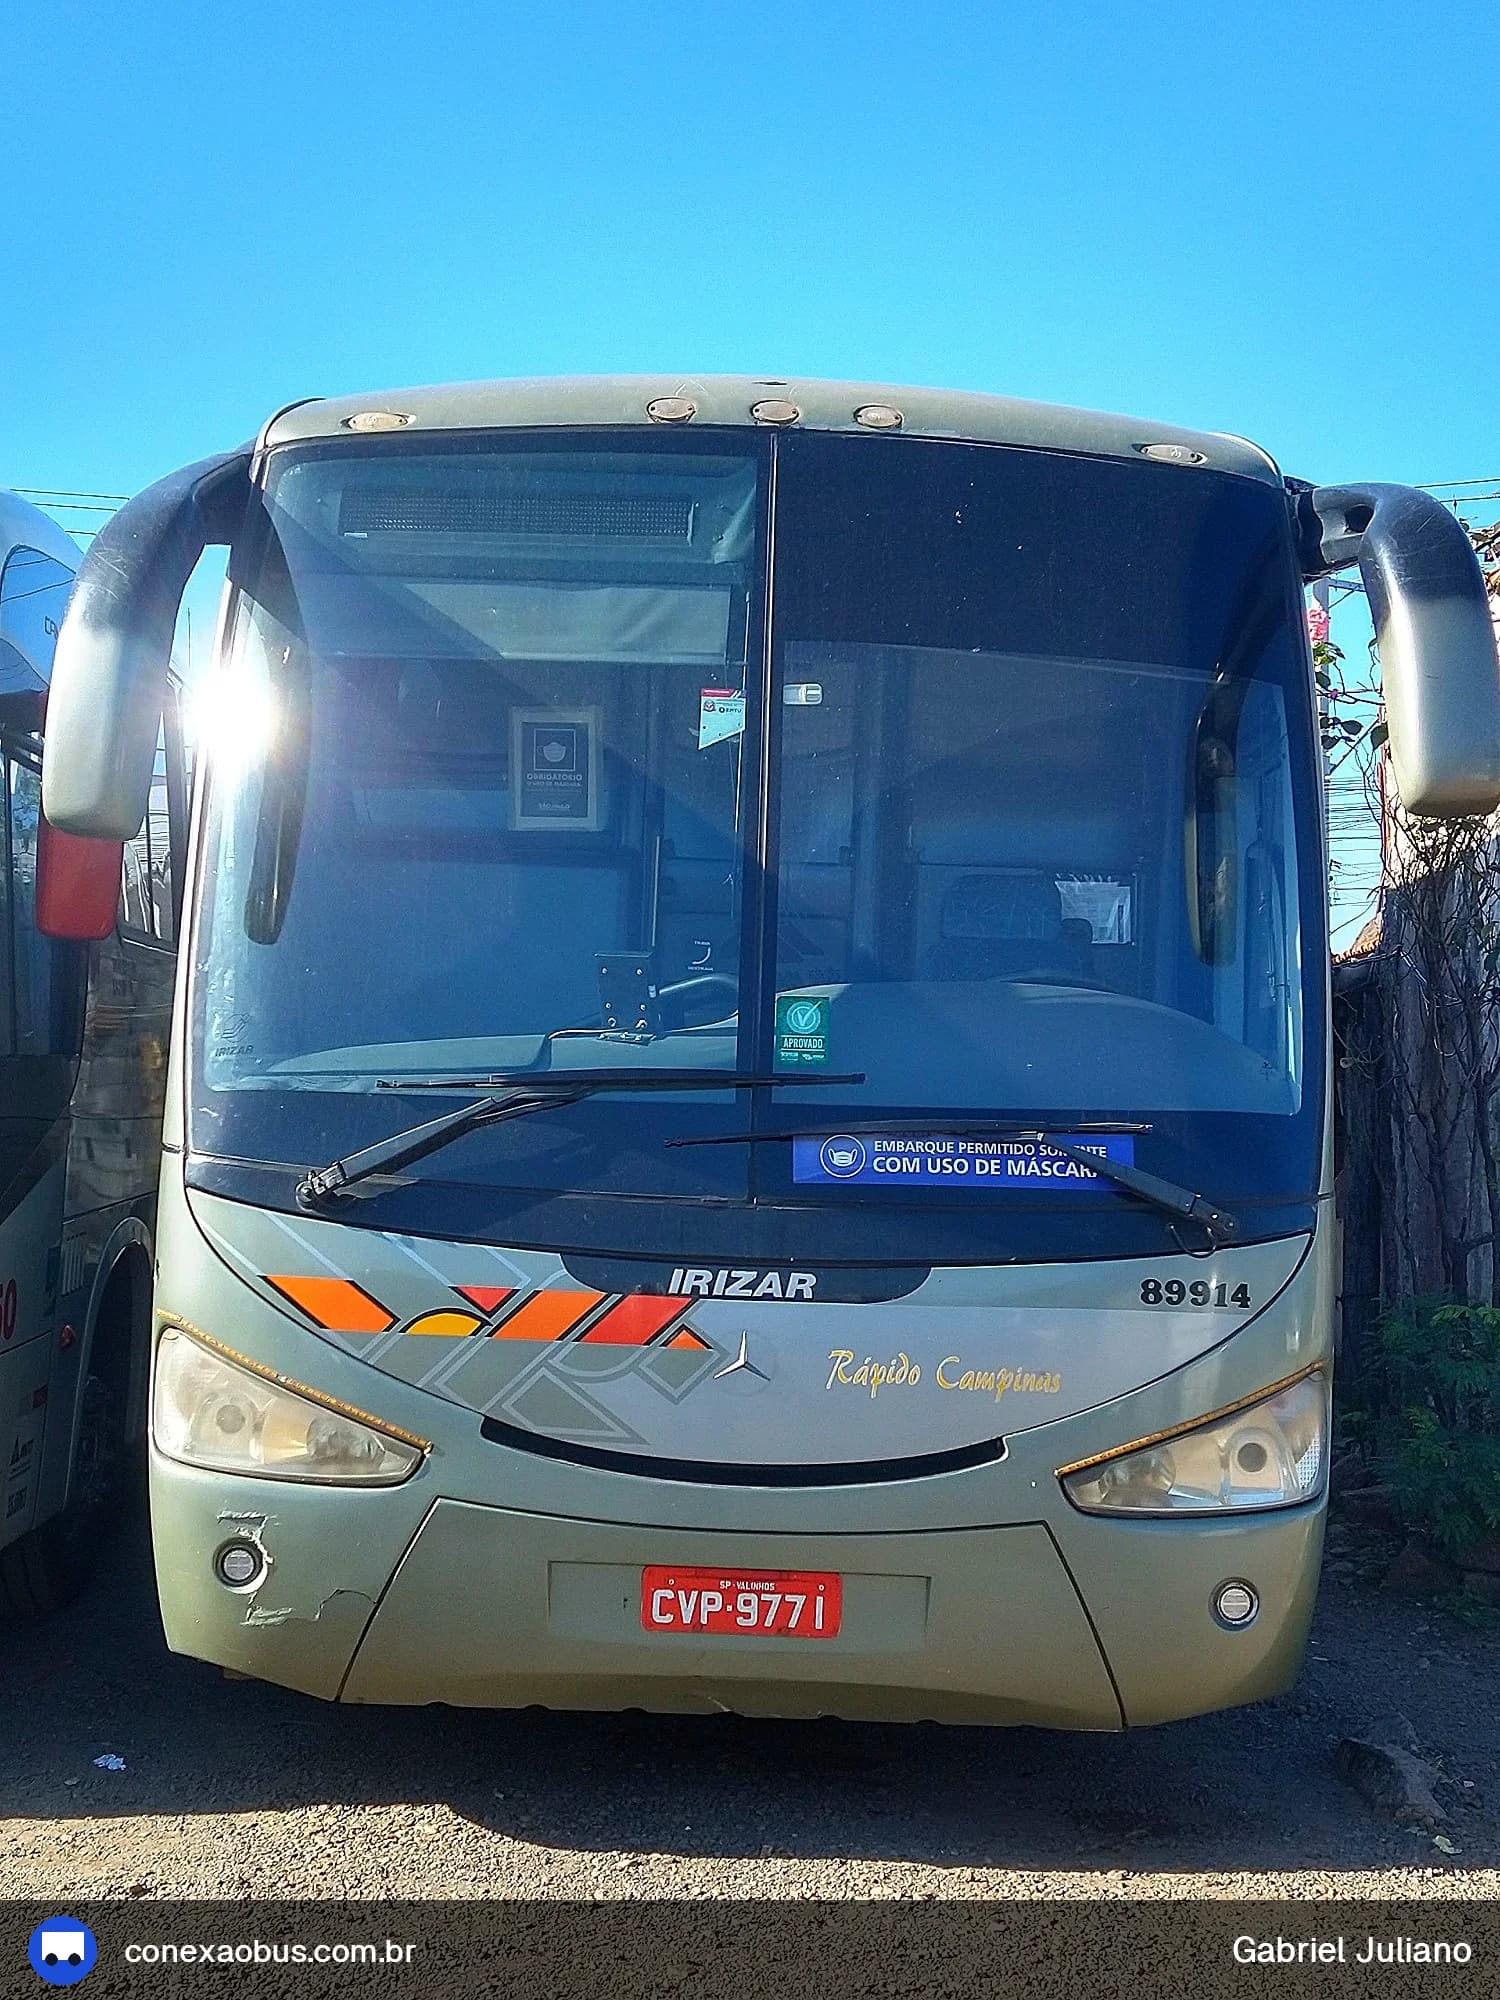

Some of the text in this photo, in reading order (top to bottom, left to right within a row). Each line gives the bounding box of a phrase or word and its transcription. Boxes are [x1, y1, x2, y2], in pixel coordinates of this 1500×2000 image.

[215, 1044, 254, 1057] IRIZAR
[783, 1037, 823, 1049] APROVADO
[873, 1139, 1107, 1158] EMBARQUE PERMITIDO SONTE
[872, 1156, 1098, 1179] COM USO DE MÁSCAR
[668, 1268, 817, 1299] IRIZAR
[1139, 1278, 1251, 1309] 89914
[825, 1348, 1061, 1404] Rápido Campinas
[719, 1580, 775, 1591] SP VALINHOS
